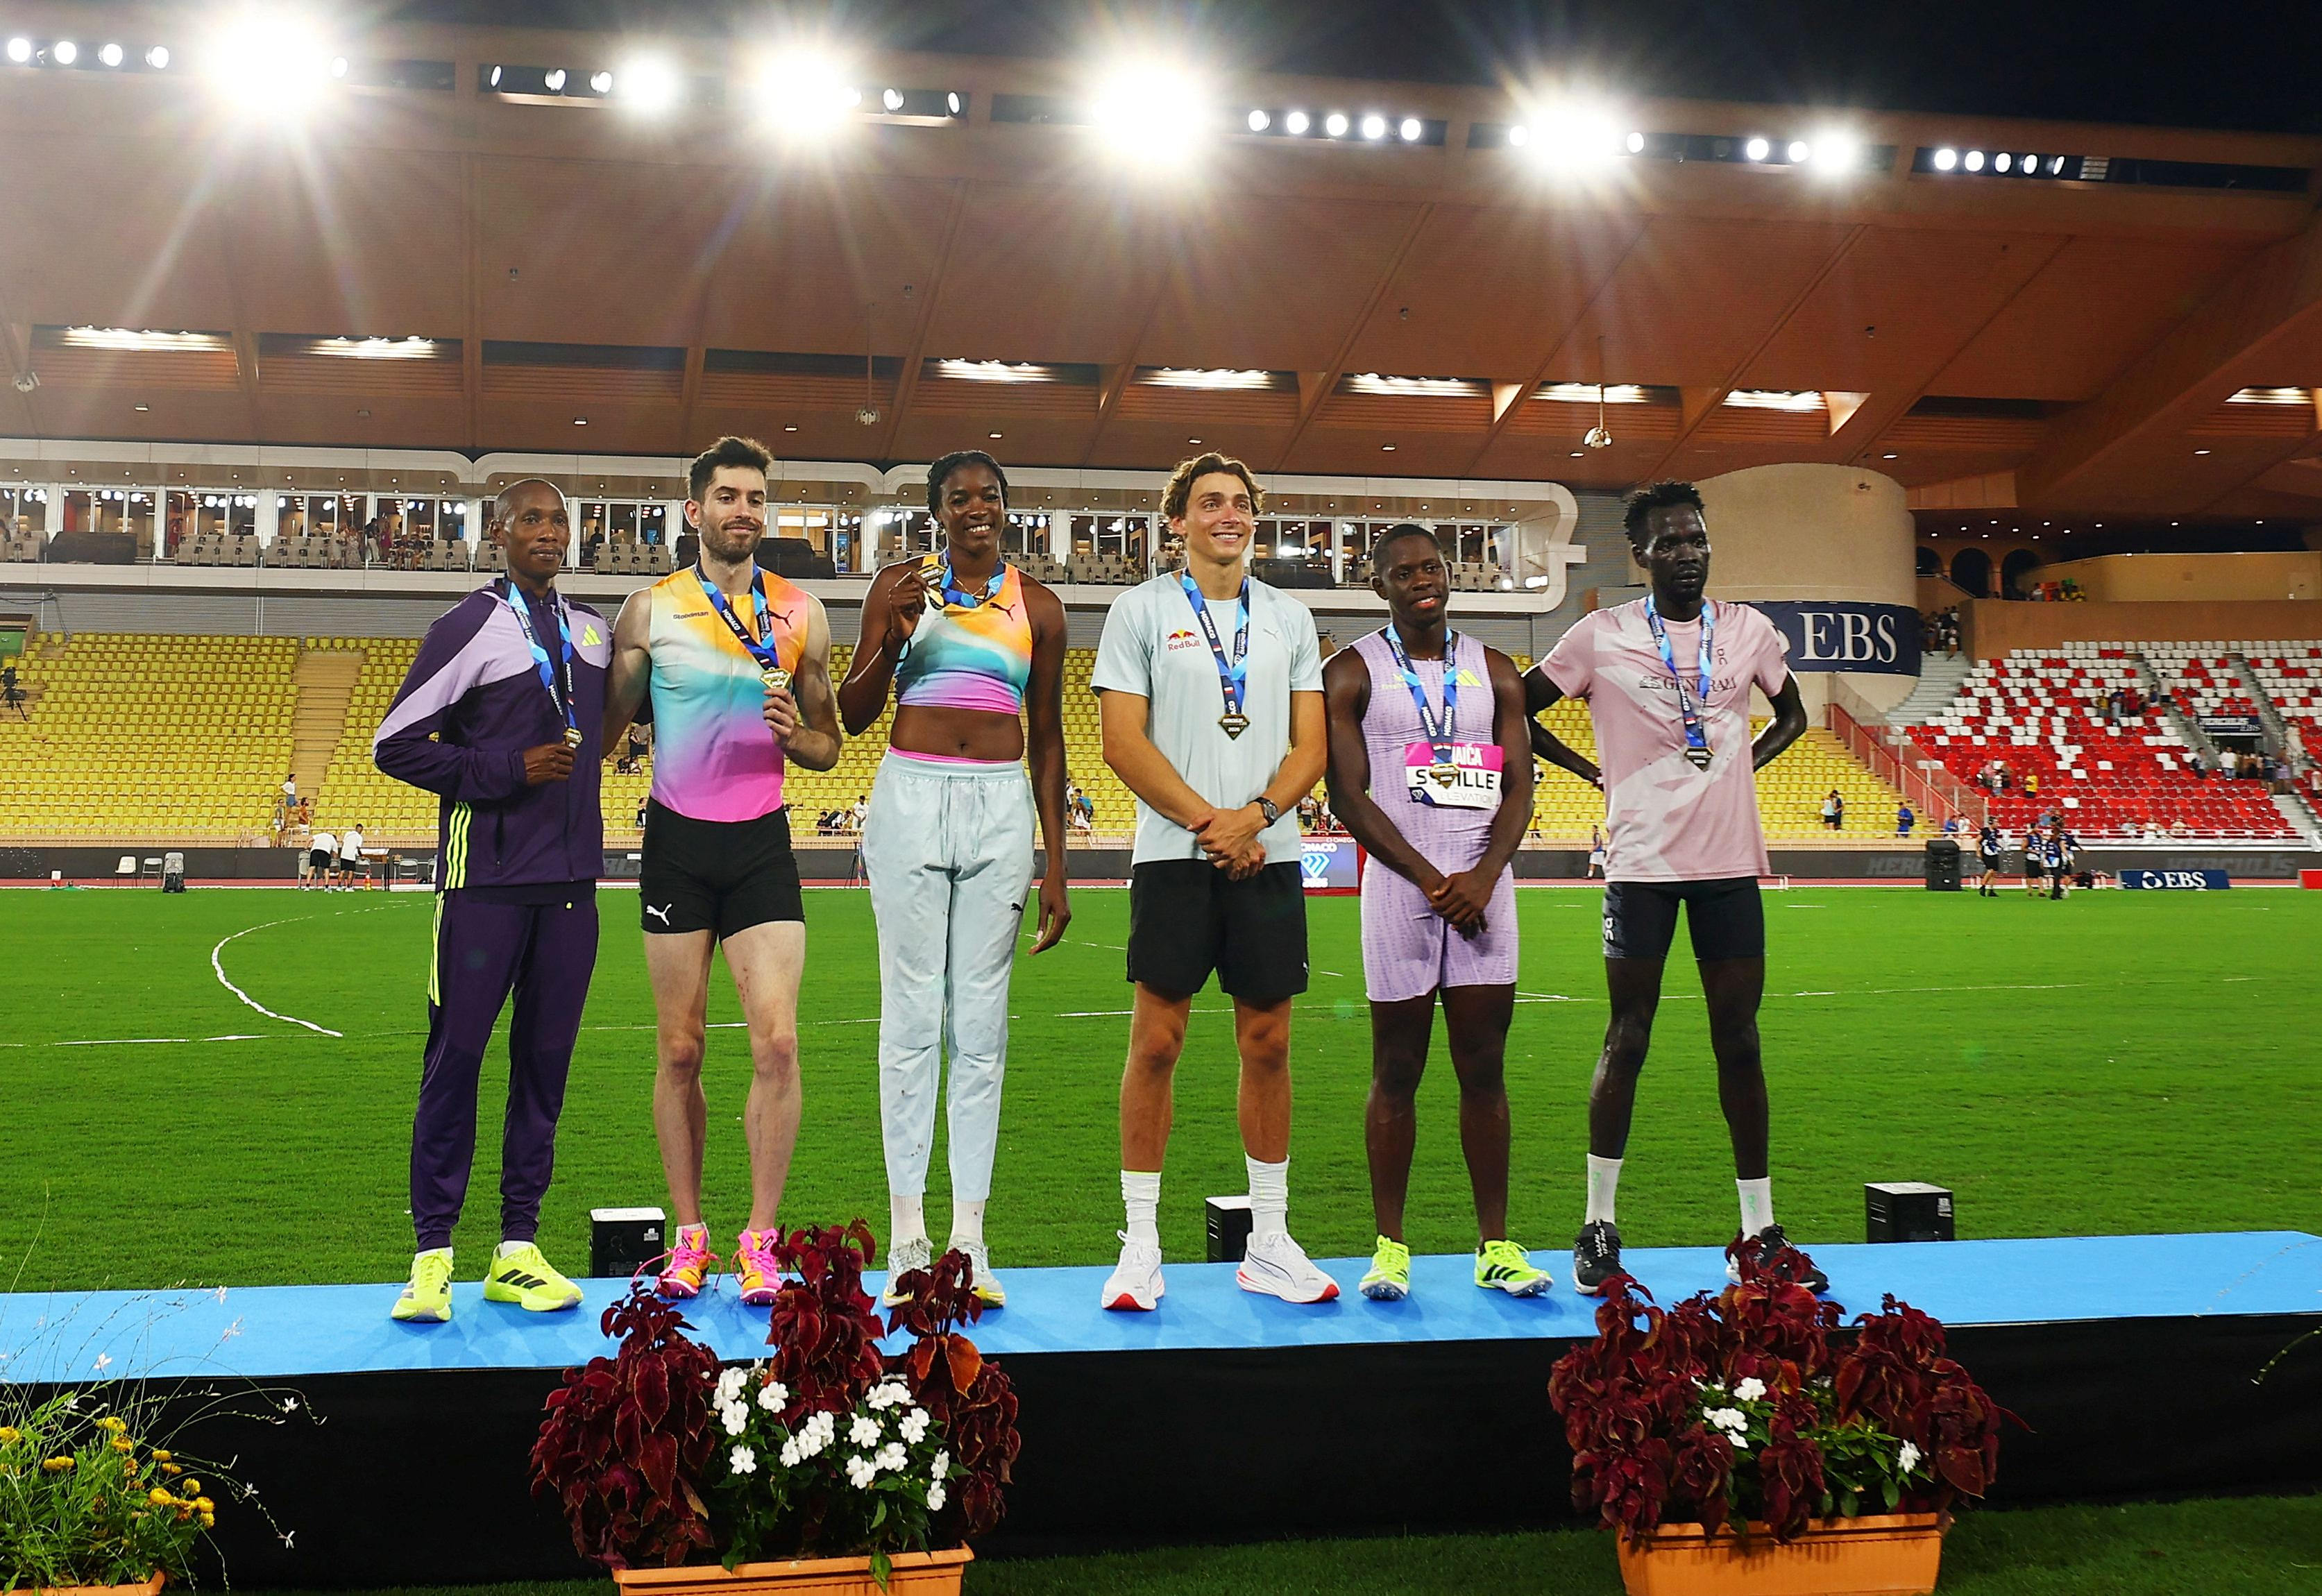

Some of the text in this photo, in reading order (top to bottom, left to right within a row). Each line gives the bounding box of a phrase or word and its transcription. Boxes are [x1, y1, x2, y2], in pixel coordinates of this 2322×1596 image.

[722, 609, 741, 631] MONACO
[1199, 610, 1217, 639] MONACO
[1168, 640, 1201, 651] Red Bull
[1797, 612, 1897, 663] EBS
[1421, 706, 1438, 737] MONACO
[1443, 706, 1453, 737] MONACO
[1416, 769, 1495, 790] SILLE
[1300, 842, 1338, 853] ONACO
[2162, 872, 2207, 888] EBS
